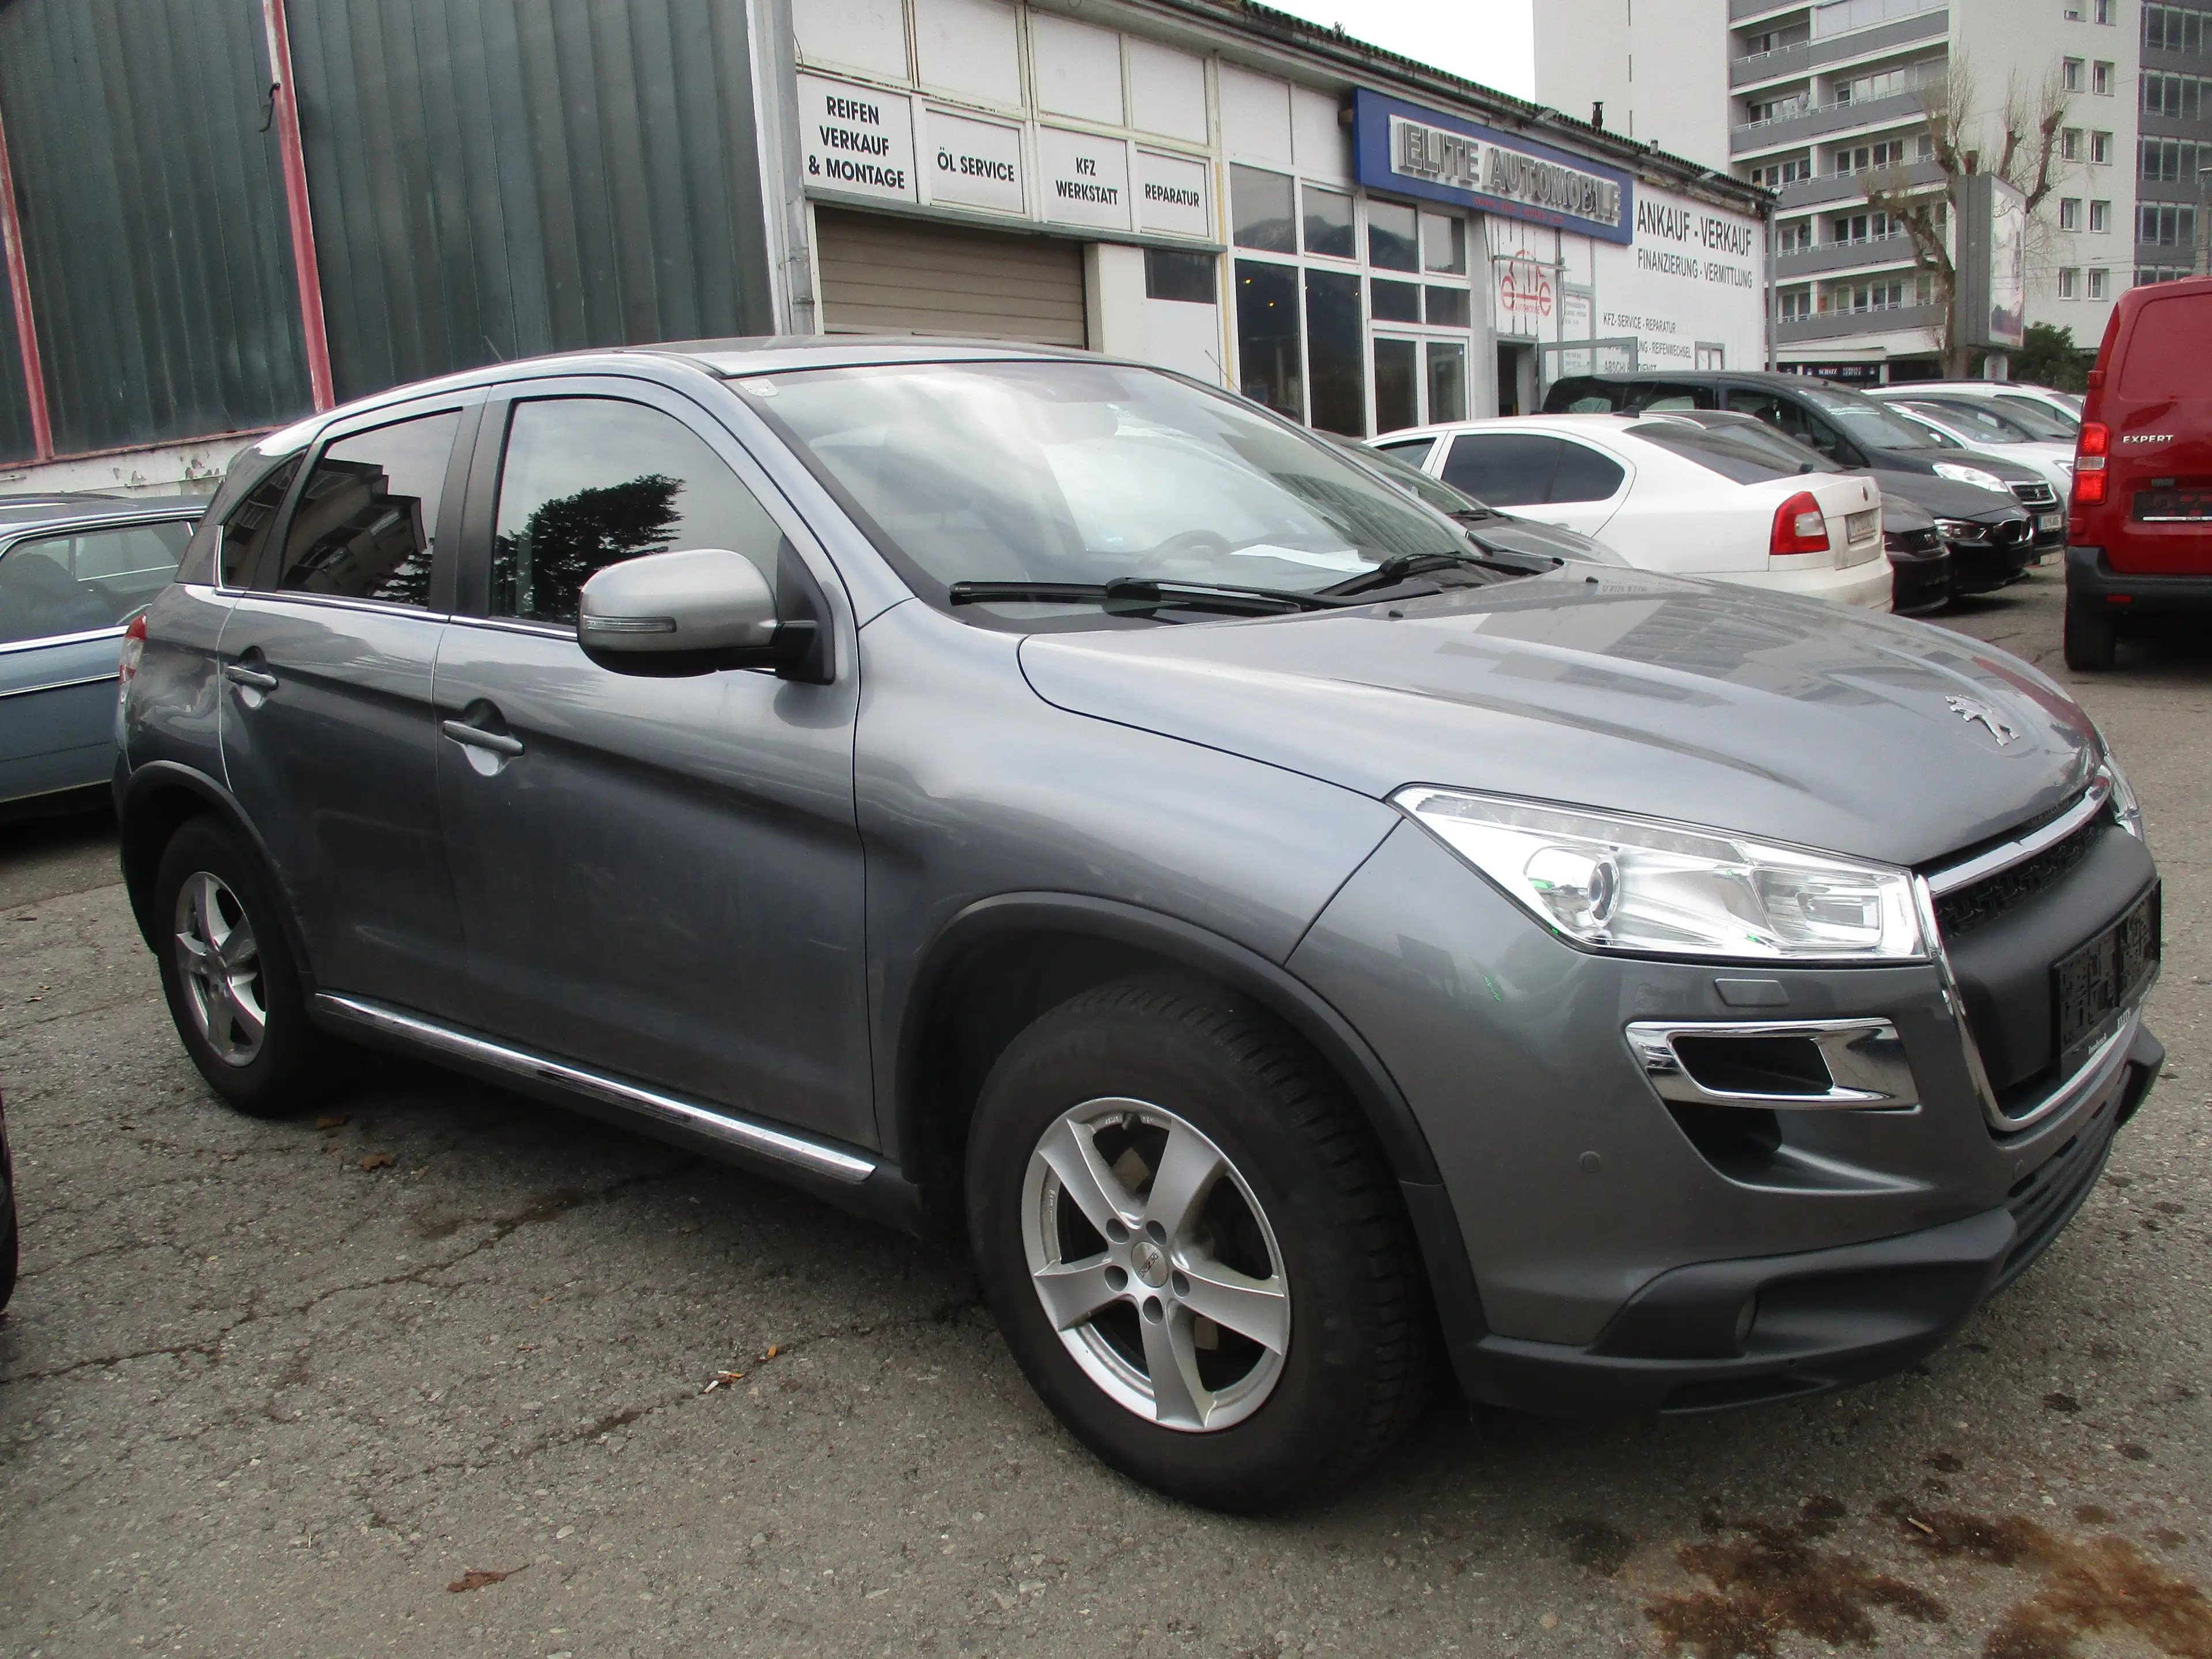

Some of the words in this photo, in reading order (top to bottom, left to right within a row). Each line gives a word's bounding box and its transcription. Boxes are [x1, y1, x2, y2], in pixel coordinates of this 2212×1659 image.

[825, 95, 880, 126] REIFEN
[819, 125, 889, 157] VERKAUF
[808, 154, 820, 176] &
[826, 158, 905, 190] MONTAGE
[937, 146, 956, 172] ÖL
[960, 156, 1014, 182] SERVICE
[1075, 157, 1096, 177] KFZ
[1398, 122, 1480, 183] ELITE
[1483, 147, 1621, 221] AUTOMOBILE
[1055, 180, 1118, 206] WERKSTATT
[1145, 183, 1200, 208] REPARATUR
[1637, 199, 1691, 242] ANKAUF
[1700, 216, 1752, 257] VERKAUF
[1638, 248, 1698, 279] FINANZIERUNG
[1703, 262, 1752, 289] VERMITTLUNG
[1618, 315, 1641, 329] SERVICE
[1646, 318, 1676, 334] REPARATUR
[2122, 434, 2175, 444] EXPERT
